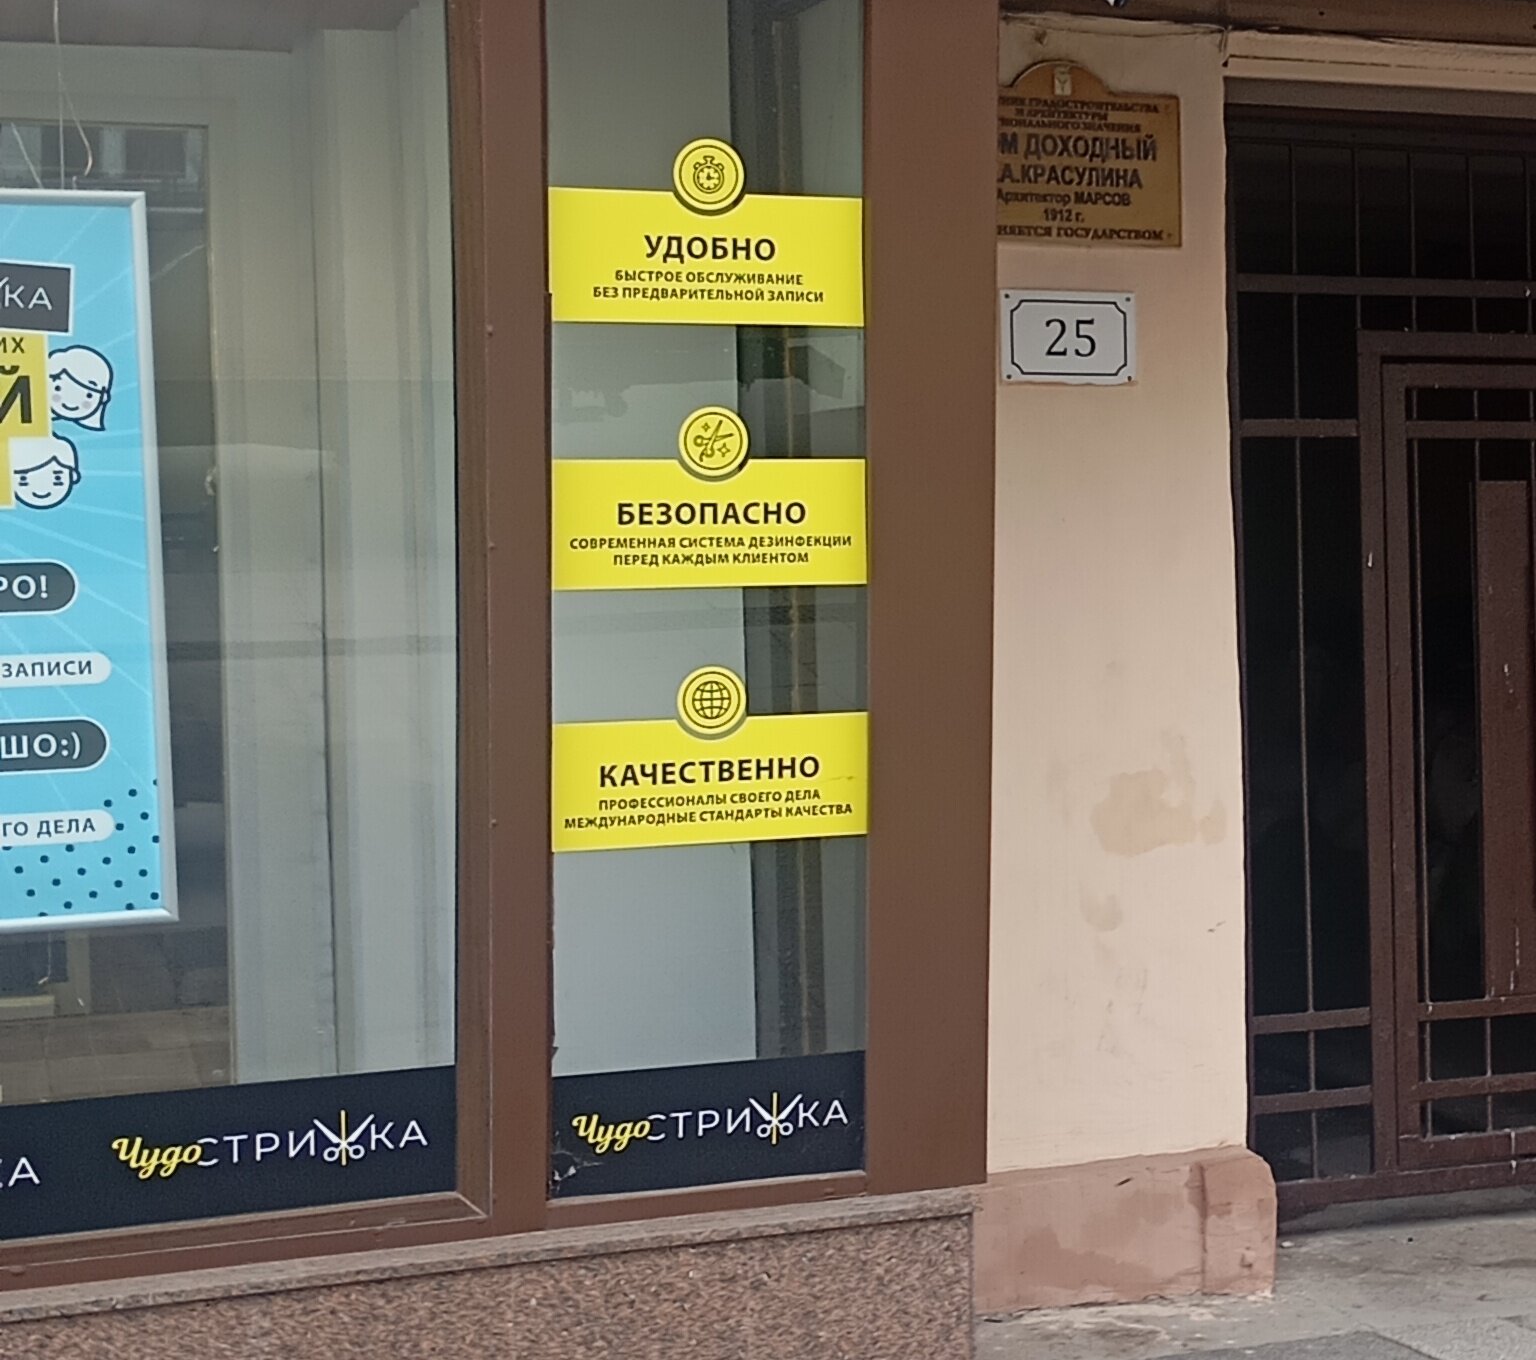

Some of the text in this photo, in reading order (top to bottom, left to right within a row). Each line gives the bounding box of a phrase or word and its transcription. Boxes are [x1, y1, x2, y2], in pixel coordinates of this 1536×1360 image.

[1024, 133, 1157, 163] ДОХОДНЫЙ
[1074, 191, 1132, 207] МАРСОВ
[1044, 208, 1073, 223] 1912
[644, 235, 776, 263] УДОБНО
[615, 270, 804, 285] БЫСТРОЕ ОБСЛУЖИВАНИЕ
[593, 286, 824, 303] БЕЗ ПРЕДВАРИТЕЛЬНОЙ ЗАПИСИ
[1045, 318, 1097, 357] 25
[617, 502, 807, 526] БЕЗОПАСНО
[570, 535, 852, 550] СОВРЕМЕННАЯ СИСТЕМА ДЕЗИНФЕКЦИИ
[613, 552, 809, 567] ПЕРЕД КАЖДЫМ КЛИЕНТОМ
[2, 660, 93, 678] ЗАПИСИ
[600, 755, 820, 788] КАЧЕСТВЕННО
[599, 789, 821, 811] ПРОФЕССИОНАЛЫ СВОЕГО ДЕЛА
[564, 804, 853, 829] МЕЖДУНАРОДНЫЕ СТАНДАРТЫ КАЧЕСТВА
[37, 818, 96, 838] ДЕЛА
